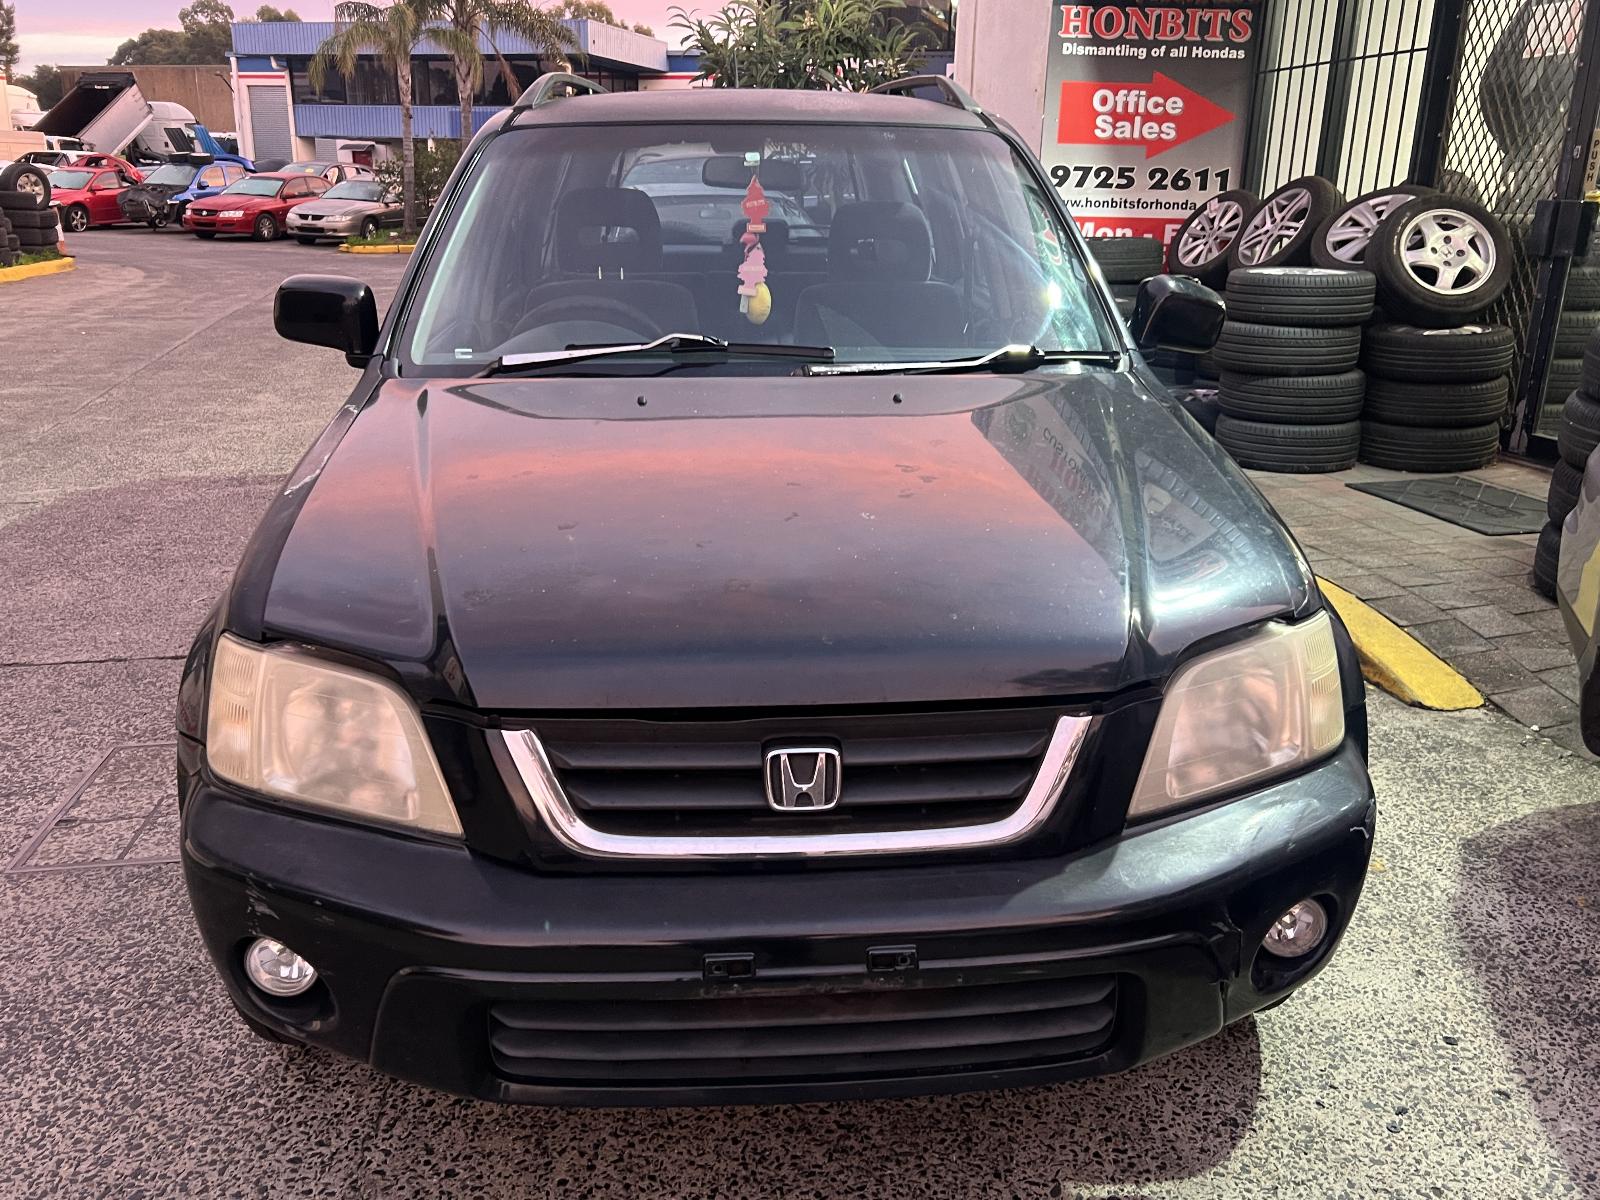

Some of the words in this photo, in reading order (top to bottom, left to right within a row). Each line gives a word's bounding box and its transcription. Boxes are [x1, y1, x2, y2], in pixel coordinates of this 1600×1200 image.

[1058, 5, 1253, 42] HONBITS
[1062, 42, 1147, 60] Dismantling
[1151, 45, 1166, 58] of
[1170, 46, 1187, 58] all
[1191, 47, 1246, 60] Hondas
[1092, 88, 1184, 116] Office
[1094, 114, 1177, 141] Sales
[1586, 139, 1600, 182] PUSH
[1050, 165, 1136, 190] 9725
[1147, 167, 1231, 193] 2611
